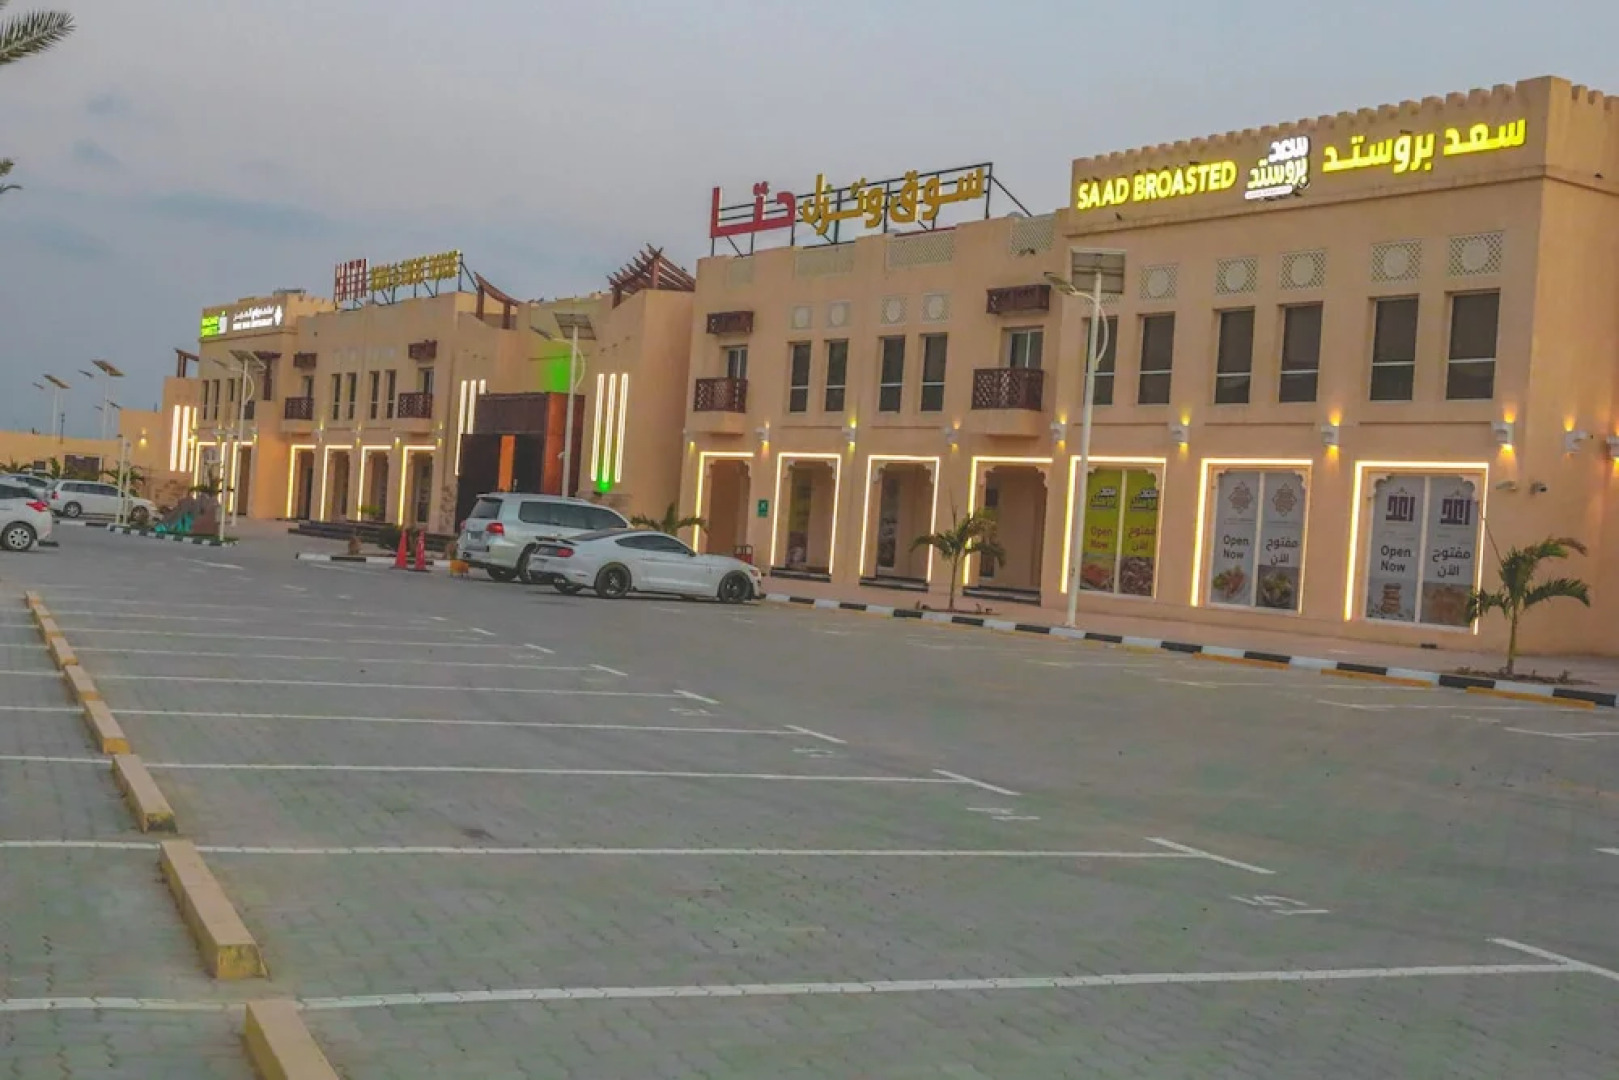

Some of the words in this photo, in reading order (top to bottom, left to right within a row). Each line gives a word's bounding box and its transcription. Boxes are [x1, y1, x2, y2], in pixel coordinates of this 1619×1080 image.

[1443, 117, 1526, 155] سعد
[1322, 132, 1435, 174] بروستد
[1077, 177, 1130, 210] SAAD
[1133, 160, 1238, 202] BROASTED
[889, 168, 985, 224] سوق
[709, 181, 795, 238] حتا
[1223, 534, 1249, 547] Open
[1265, 536, 1299, 551] مفتوح
[1223, 548, 1244, 559] Now
[1380, 544, 1411, 560] Open
[1432, 546, 1471, 563] مفتوح
[1380, 560, 1406, 573] Now
